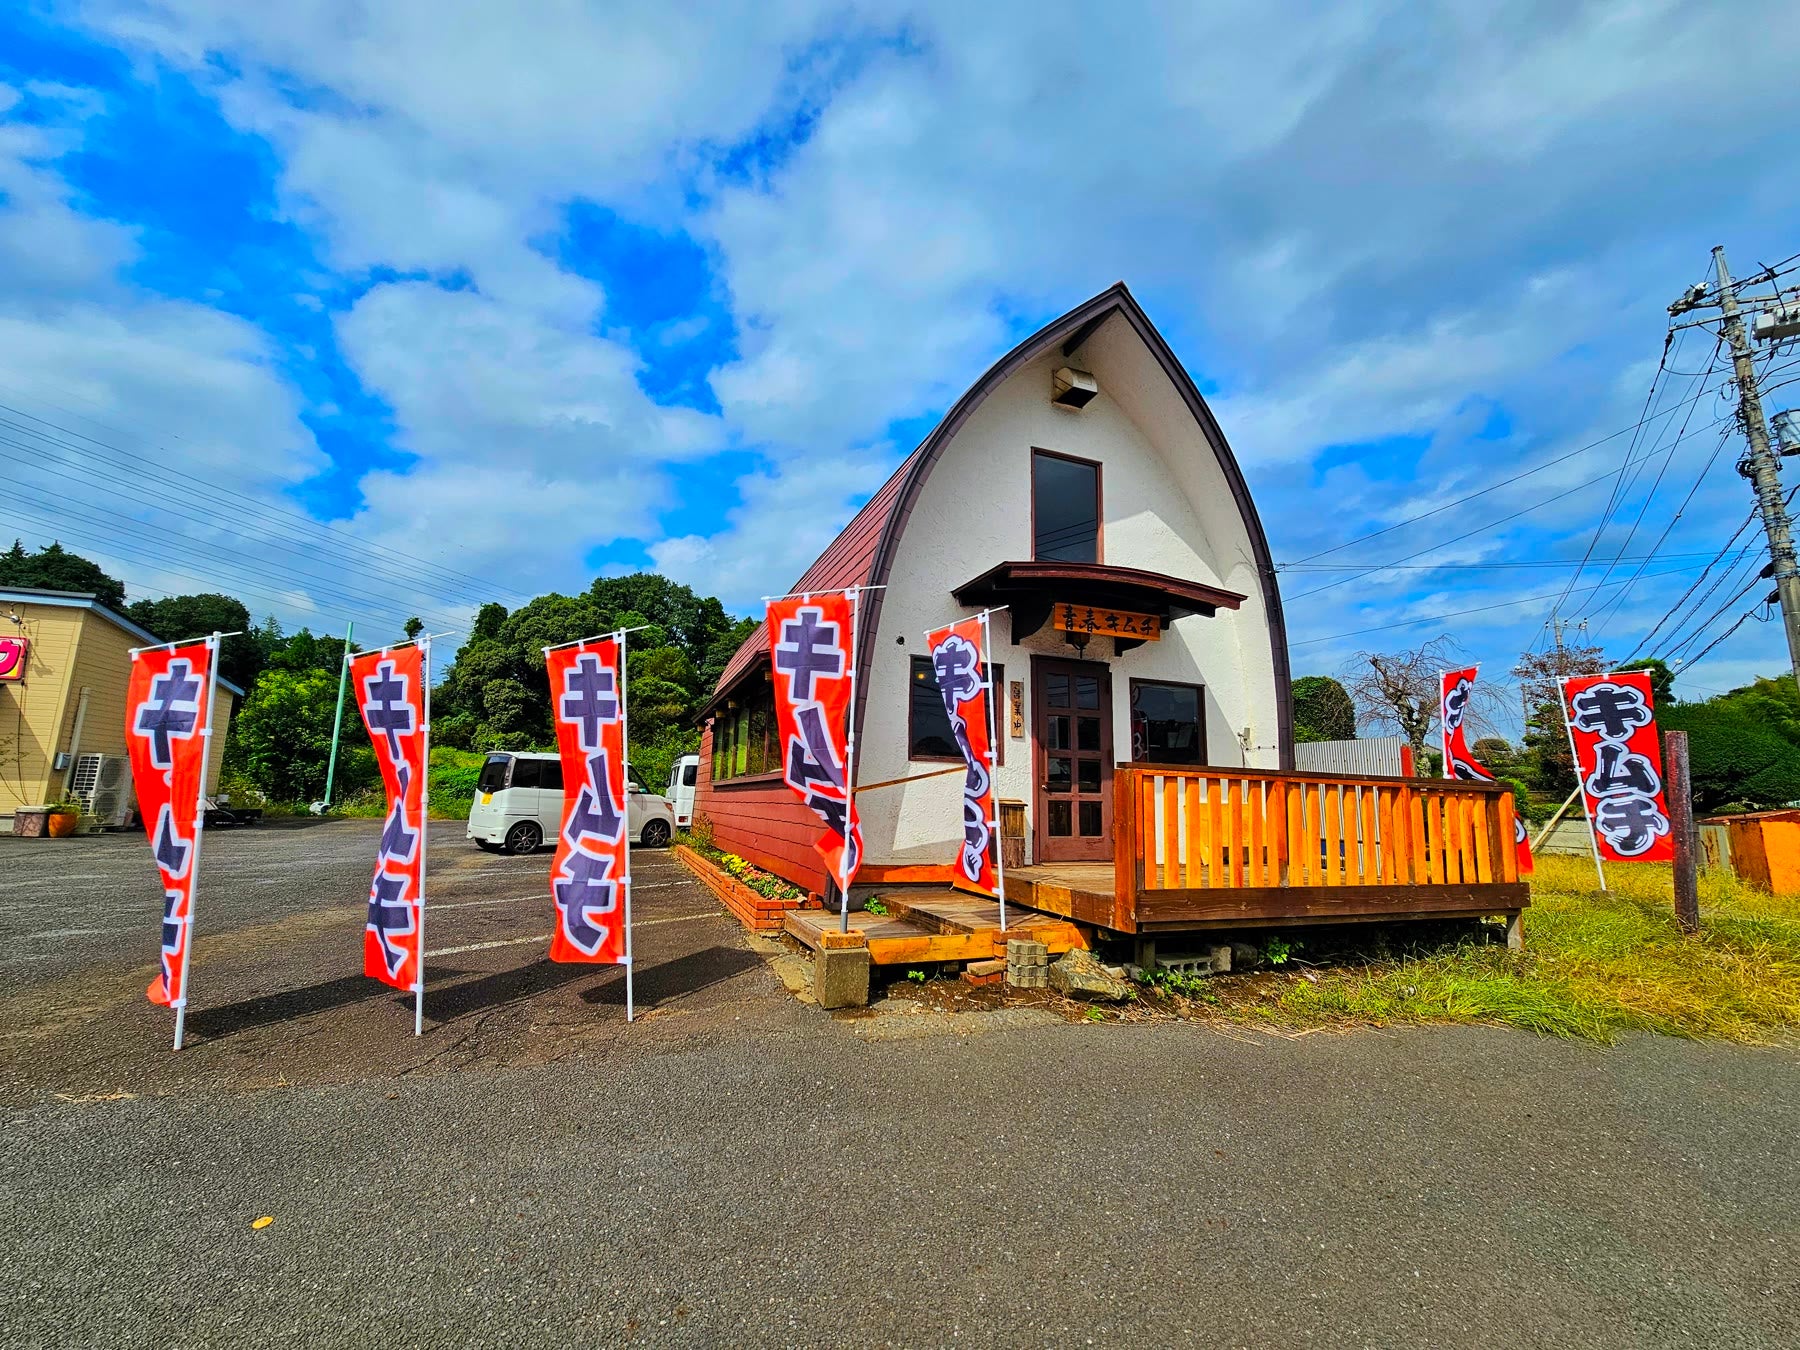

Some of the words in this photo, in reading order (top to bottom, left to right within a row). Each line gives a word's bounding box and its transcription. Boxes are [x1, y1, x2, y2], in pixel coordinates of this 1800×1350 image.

[1062, 604, 1154, 636] 青春キムチ
[554, 654, 622, 955] キムチ
[1572, 683, 1669, 856] キムチ
